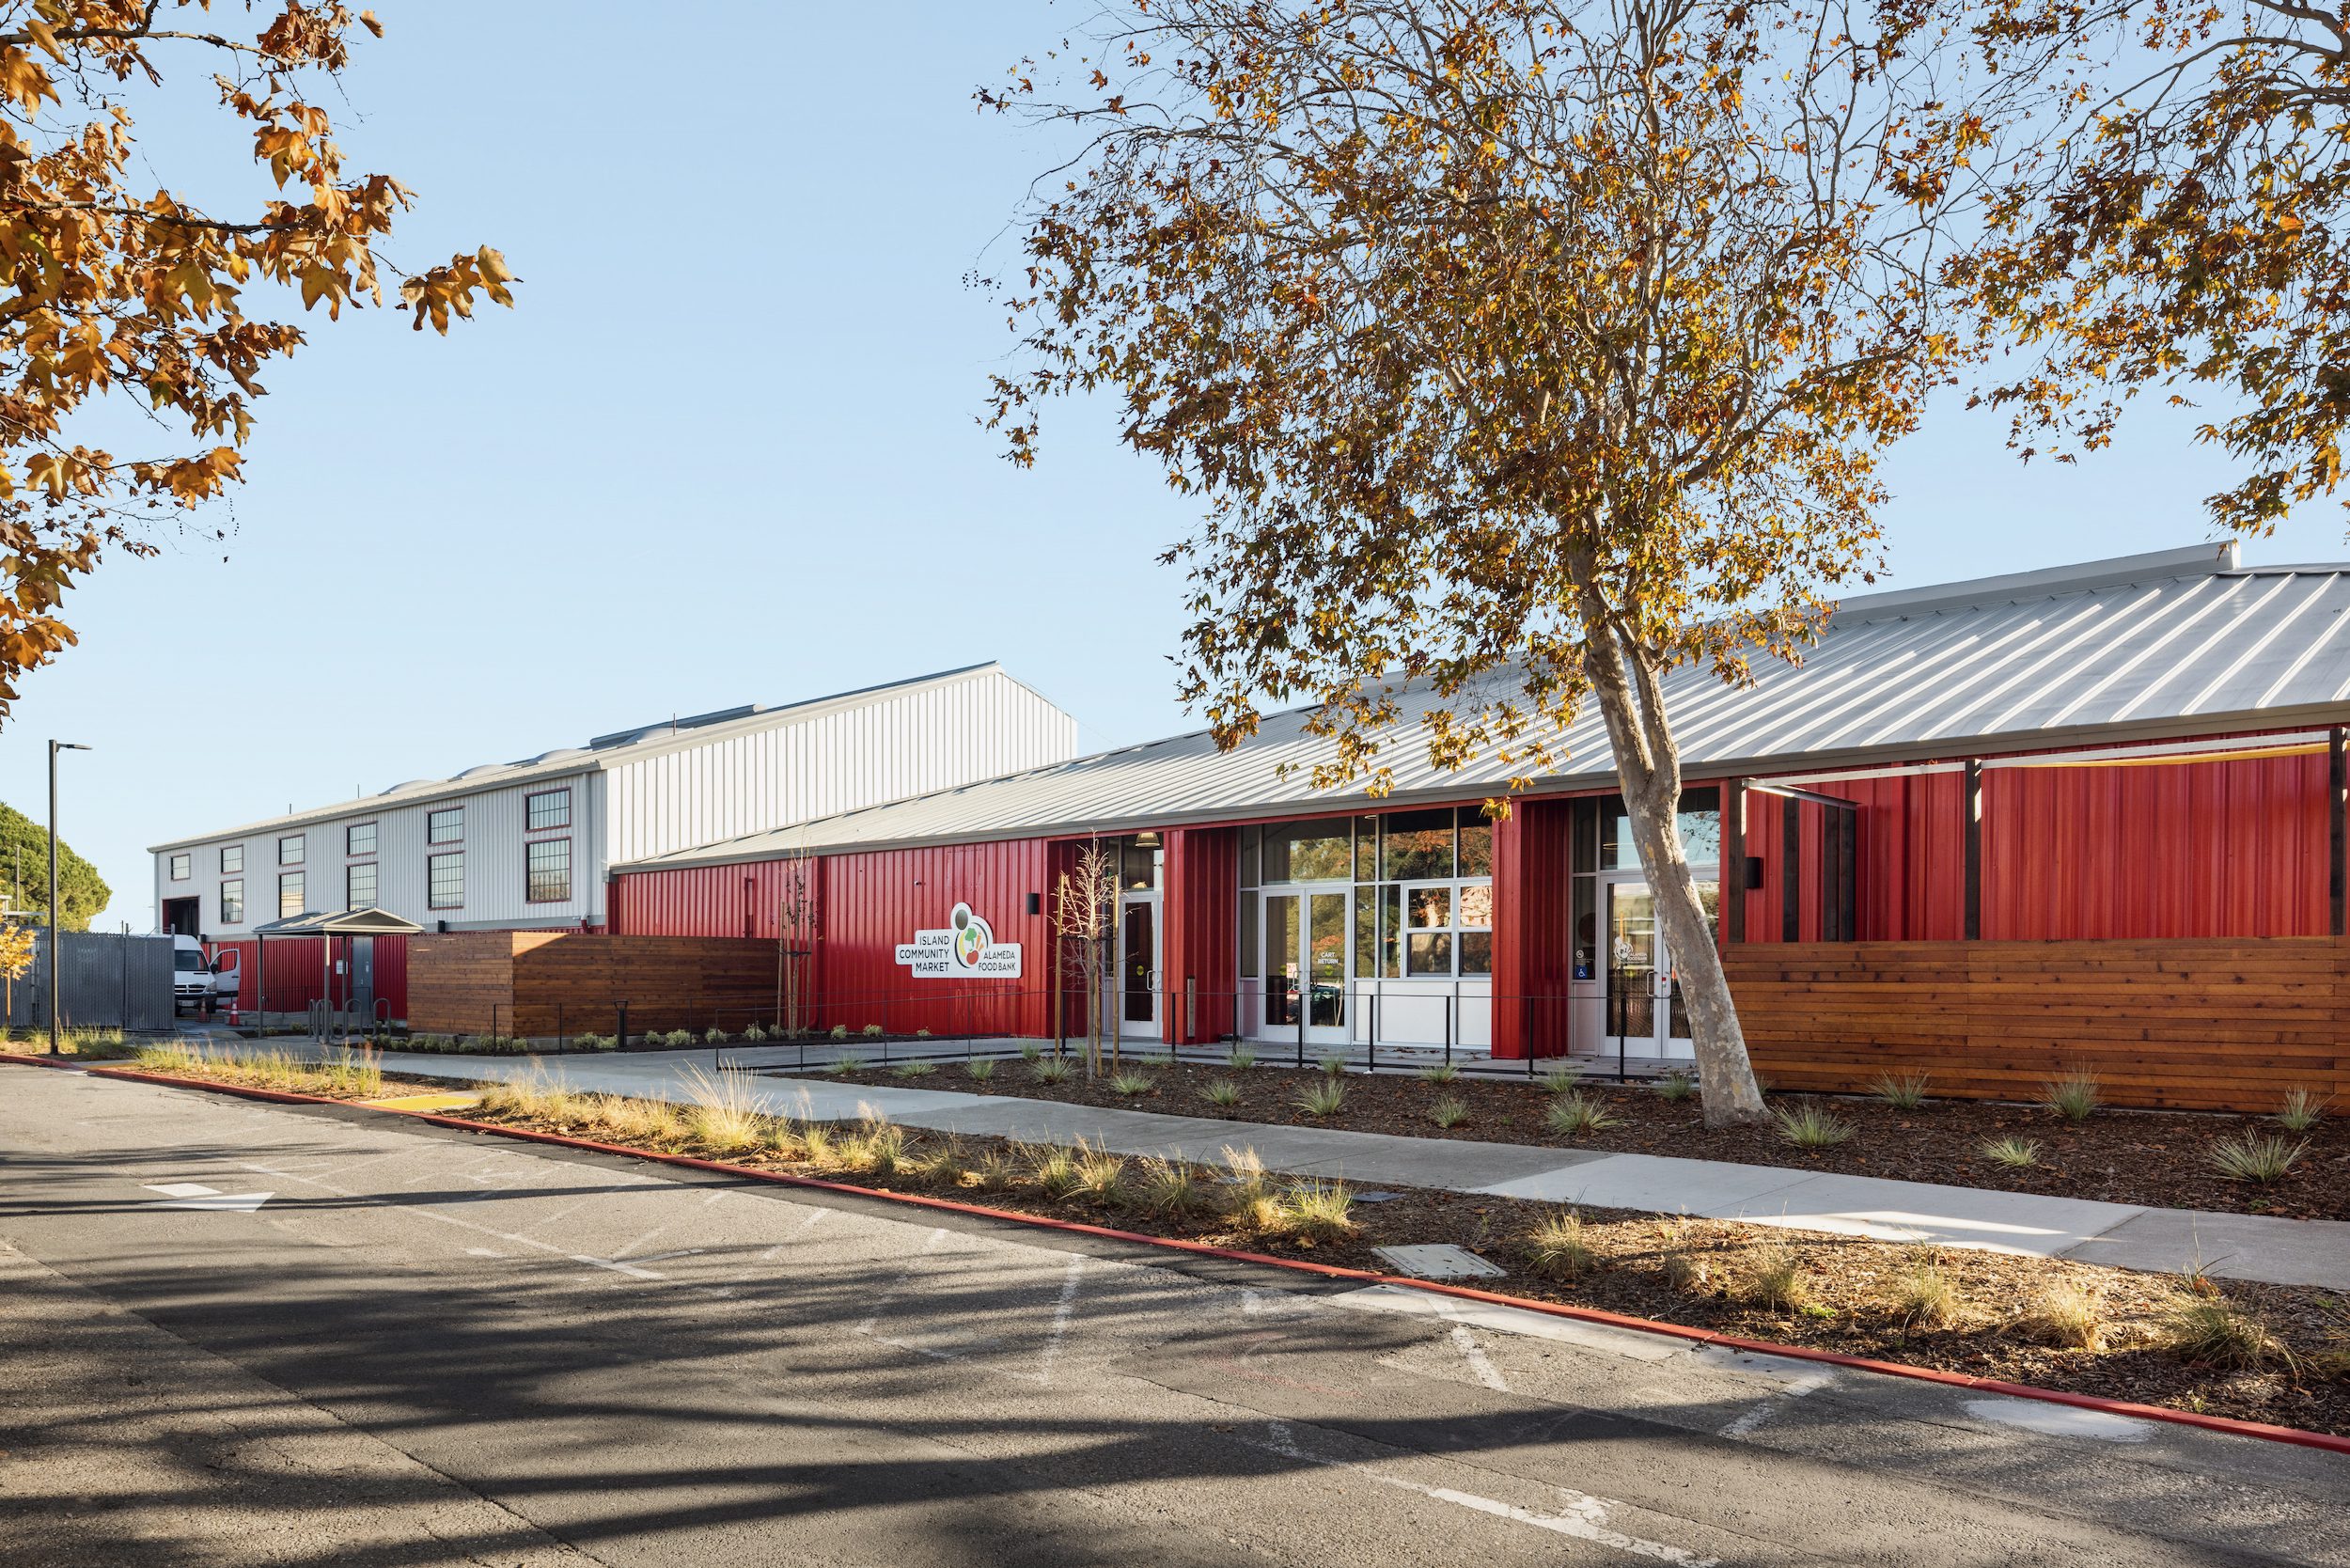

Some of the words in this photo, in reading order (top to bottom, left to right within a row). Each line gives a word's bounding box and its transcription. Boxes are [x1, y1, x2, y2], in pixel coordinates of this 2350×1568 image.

[919, 935, 949, 946] ISLAND
[900, 949, 949, 959] COMMUNITY
[983, 950, 1015, 960] ALAMEDA
[916, 962, 949, 972] MARKET
